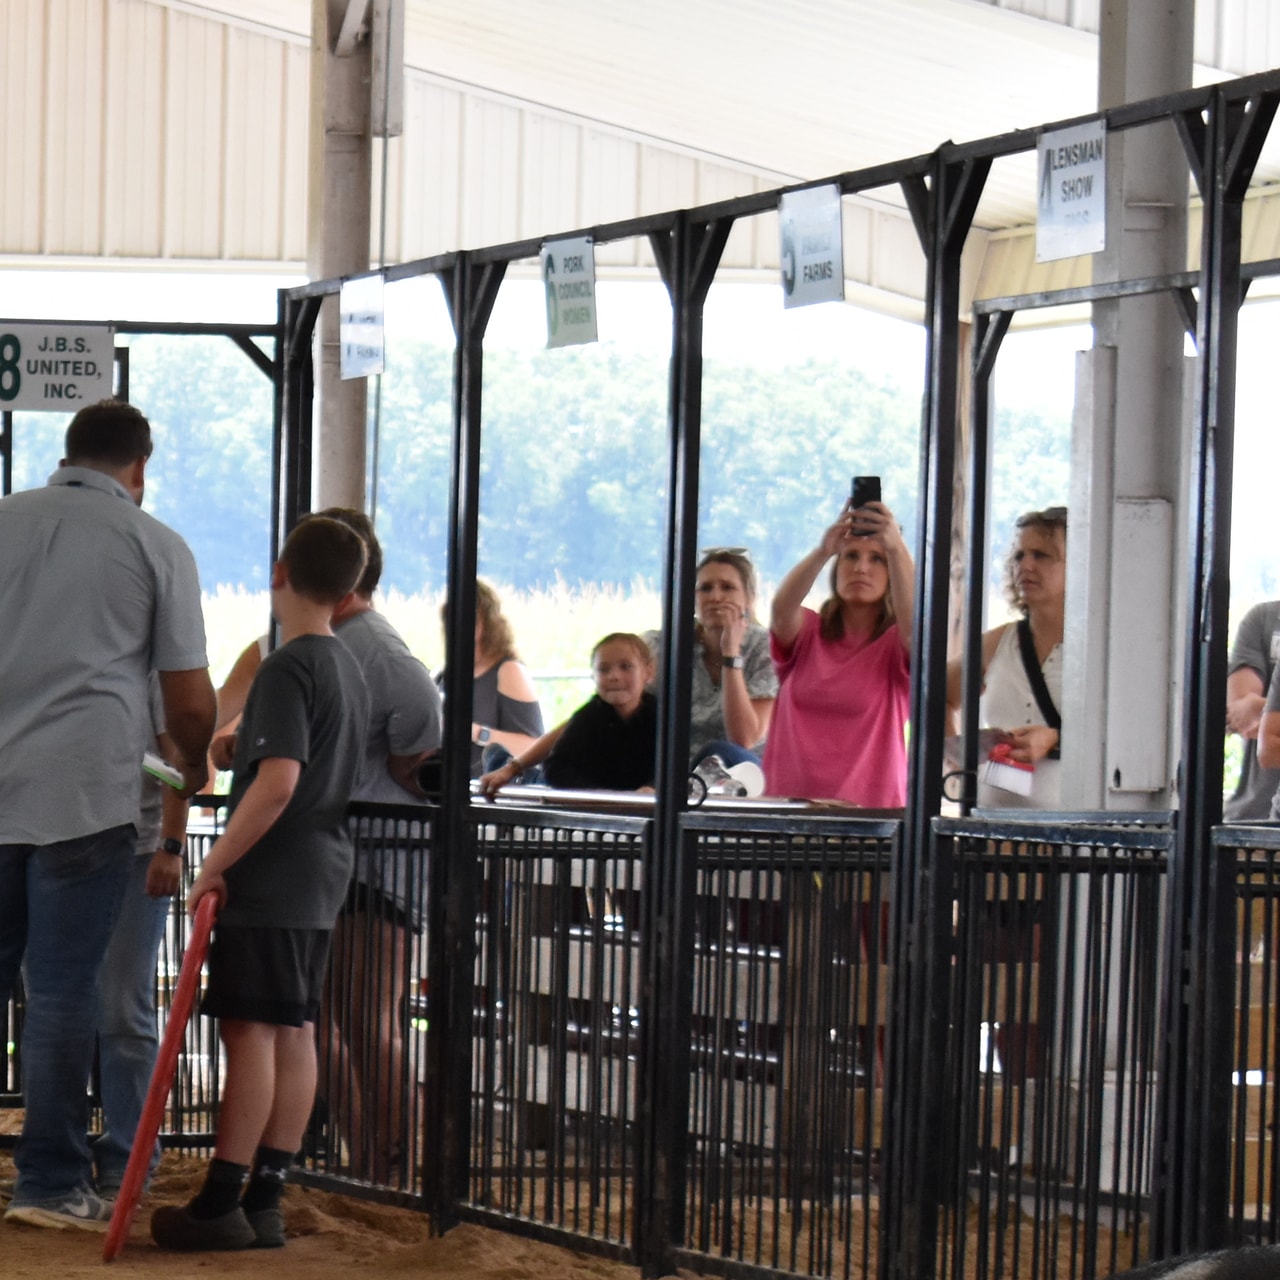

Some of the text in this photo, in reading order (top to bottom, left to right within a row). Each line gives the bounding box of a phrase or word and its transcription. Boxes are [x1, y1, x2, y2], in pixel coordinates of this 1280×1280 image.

[1051, 138, 1103, 170] LENSMAN
[1061, 175, 1093, 202] SHOW
[563, 255, 584, 273] PORK
[803, 260, 832, 283] FARMS
[545, 254, 558, 335] 6
[38, 336, 91, 353] J.B.S.
[26, 359, 102, 379] UNITED,
[44, 383, 82, 399] INC.
